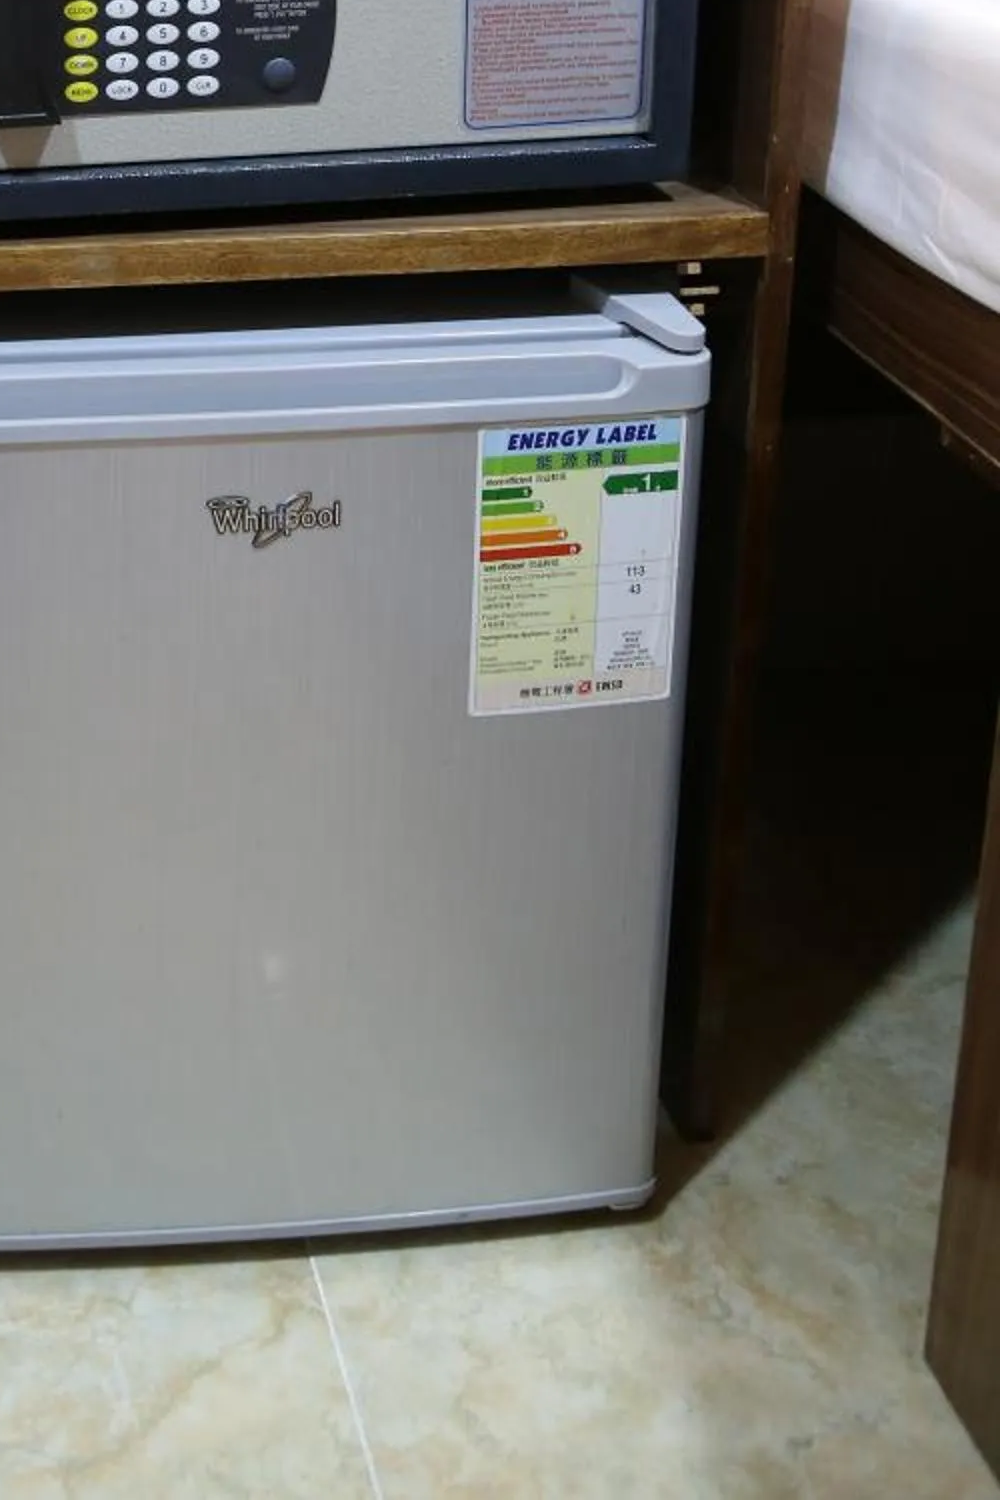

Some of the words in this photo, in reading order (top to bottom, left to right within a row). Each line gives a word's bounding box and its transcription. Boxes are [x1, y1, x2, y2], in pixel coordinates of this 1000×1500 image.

[507, 428, 591, 451] ENERGY
[595, 423, 658, 445] LABEL
[642, 473, 651, 491] 1
[207, 496, 342, 542] Whirlpool
[629, 583, 641, 595] 43
